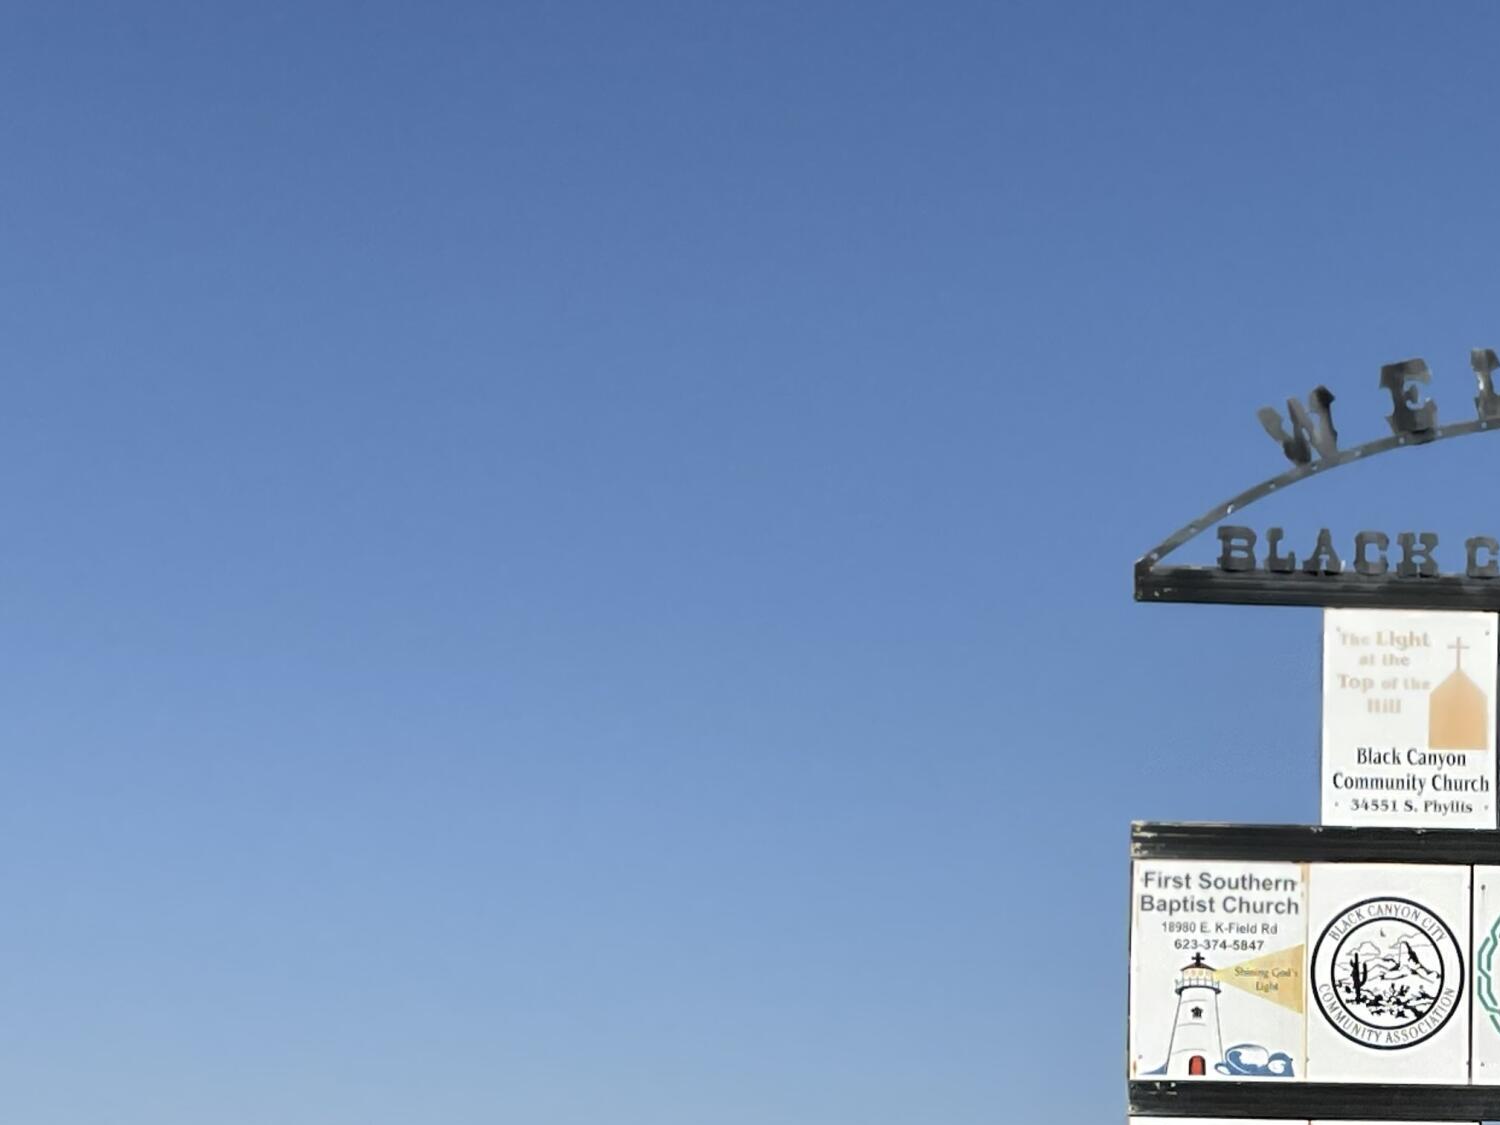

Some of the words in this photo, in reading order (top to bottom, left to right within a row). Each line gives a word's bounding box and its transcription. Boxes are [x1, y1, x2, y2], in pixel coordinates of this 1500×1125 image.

[1216, 526, 1438, 577] BLACK
[1376, 630, 1430, 651] Light
[1359, 654, 1374, 667] at
[1382, 653, 1410, 667] the
[1337, 674, 1374, 692] Top
[1381, 677, 1397, 690] of
[1402, 677, 1430, 690] the
[1367, 698, 1402, 714] Hill
[1356, 748, 1401, 766] Black
[1407, 749, 1466, 770] Canyon
[1332, 772, 1426, 796] Community
[1431, 774, 1489, 792] Church
[1350, 798, 1398, 812] 34551
[1403, 799, 1418, 813] S.
[1424, 800, 1473, 816] Phyllis
[1144, 871, 1191, 889] First
[1198, 872, 1297, 892] Southern
[1140, 895, 1216, 916] Baptist
[1222, 896, 1299, 915] Church
[1162, 922, 1196, 933] 18980
[1200, 922, 1211, 933] E.
[1215, 922, 1257, 934] K-Field
[1261, 923, 1278, 935] Rd
[1329, 908, 1366, 942] BLACK
[1367, 904, 1421, 921] CANYON
[1421, 917, 1447, 944] CITY
[1174, 939, 1265, 951] 623-374-5847
[1255, 981, 1279, 992] Light
[1319, 983, 1382, 1043] COMMUNITY
[1386, 987, 1456, 1044] ASSOCIATION
